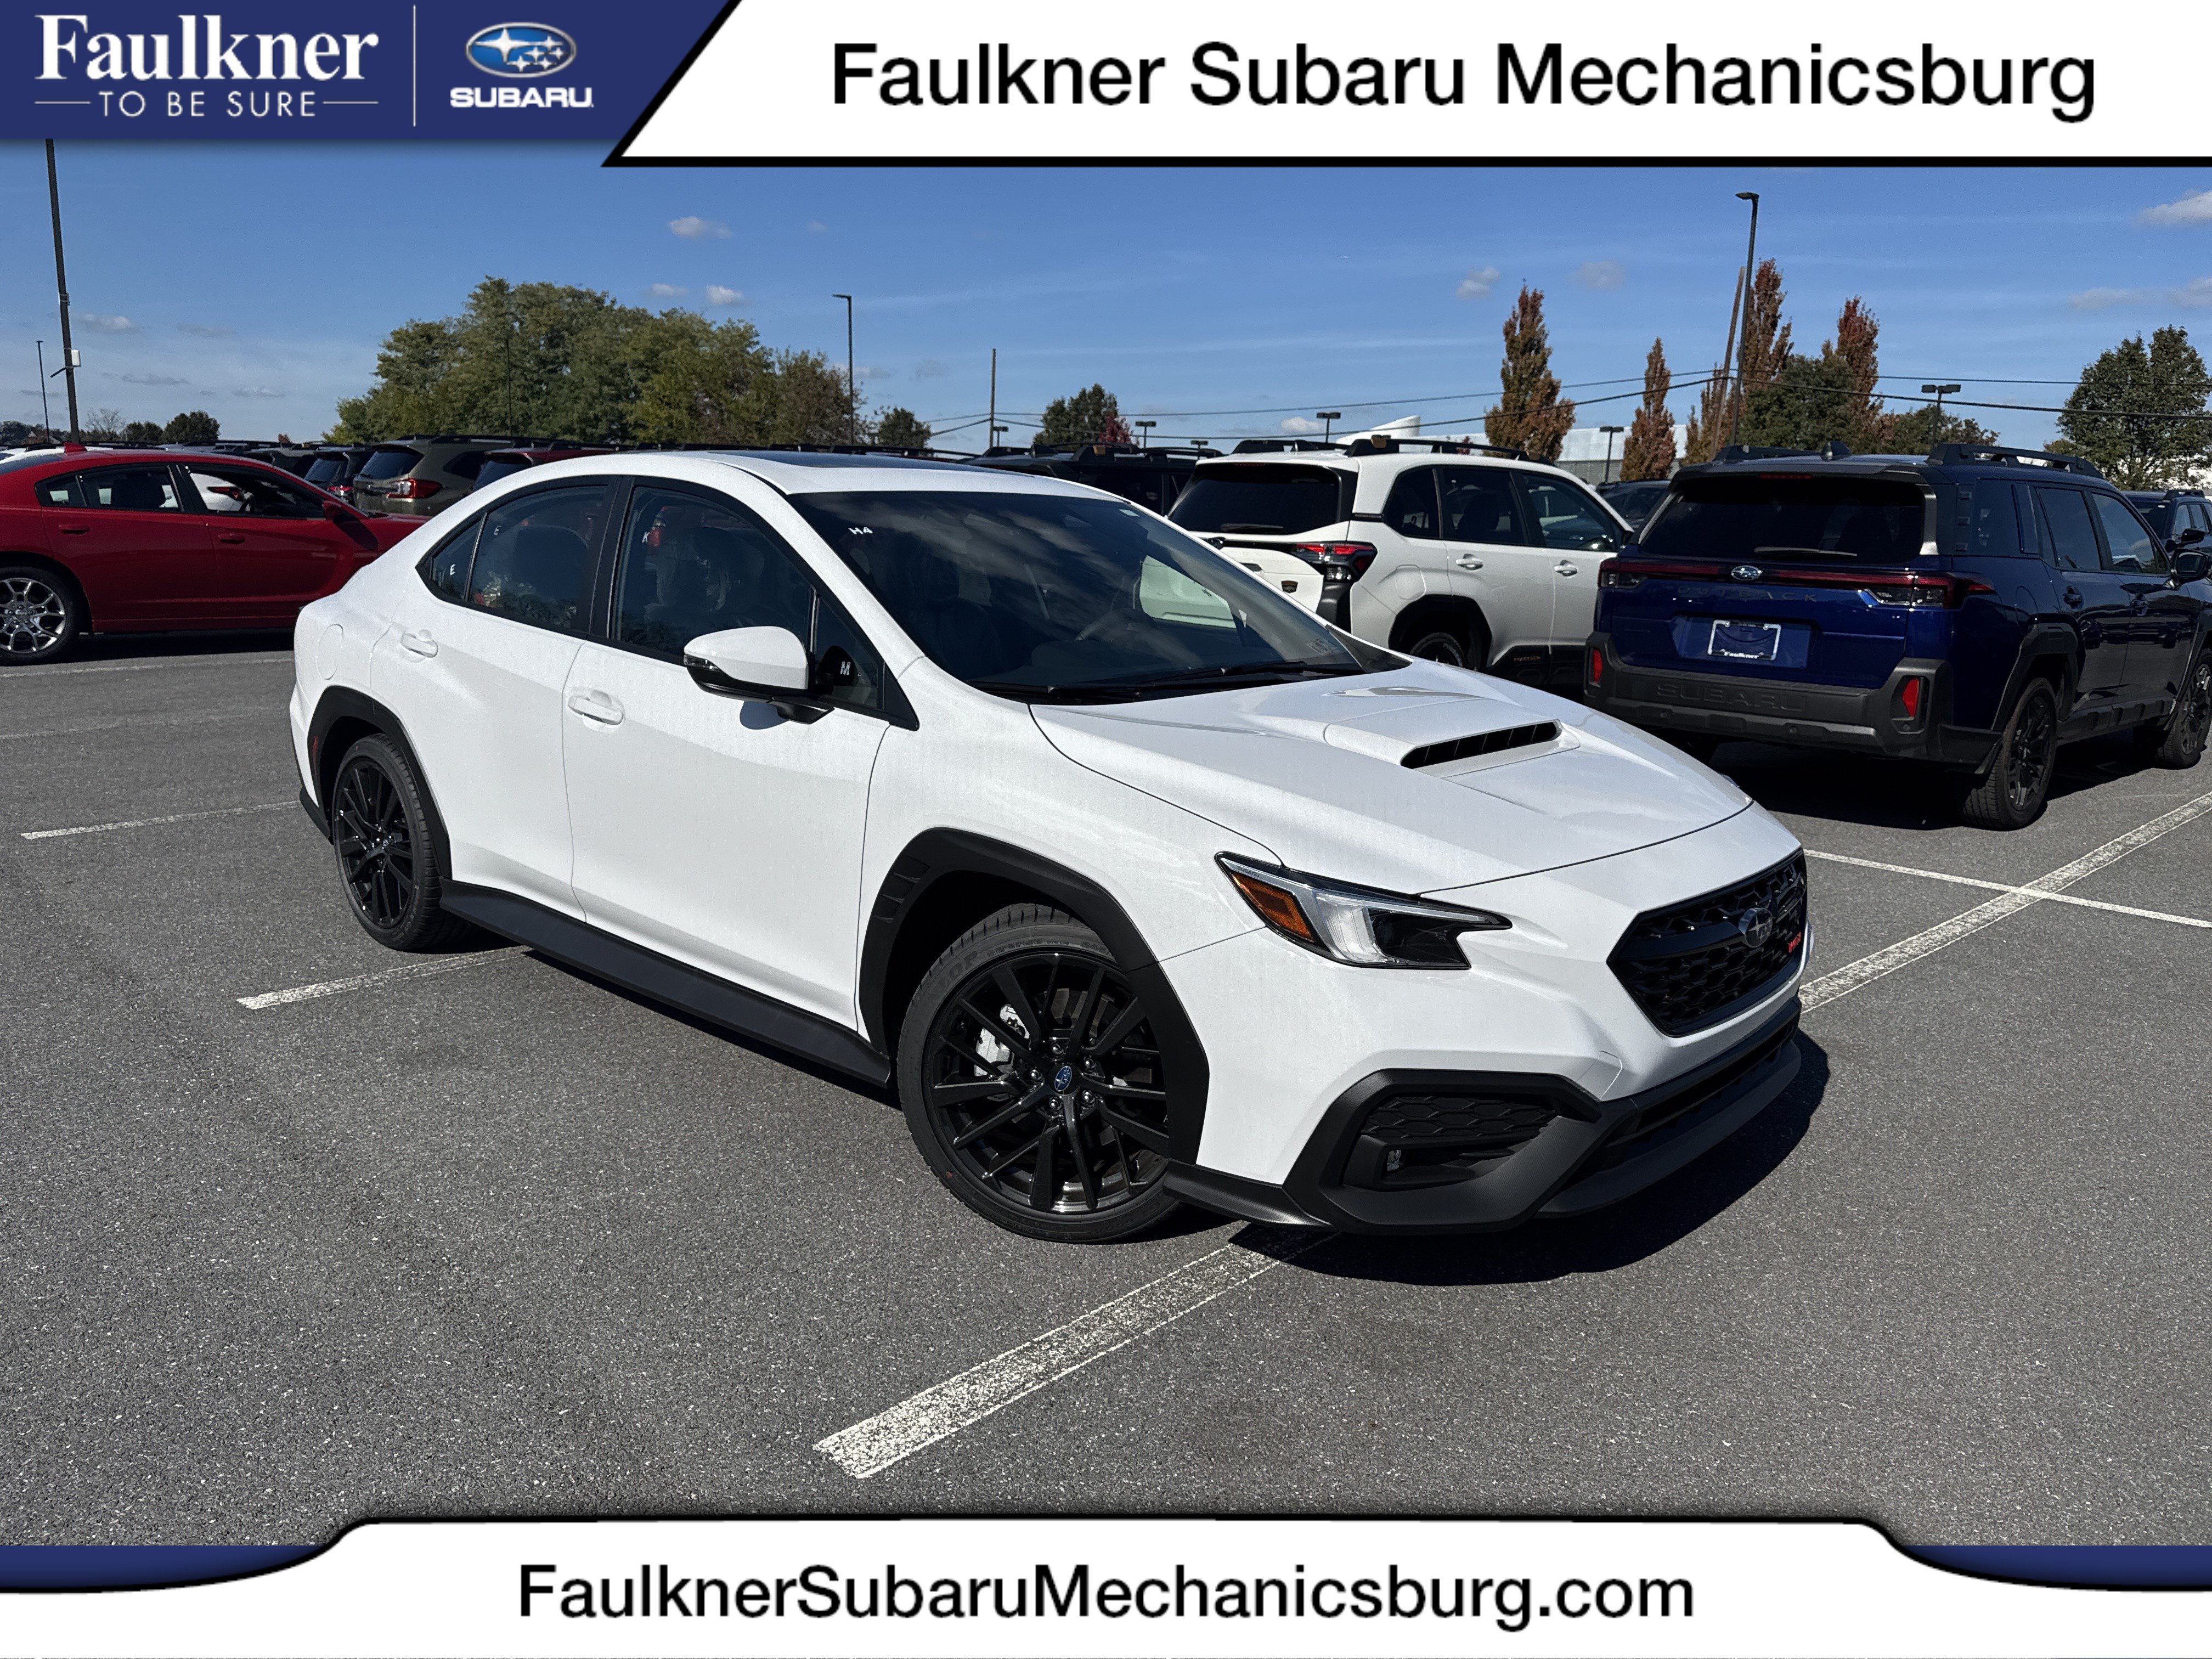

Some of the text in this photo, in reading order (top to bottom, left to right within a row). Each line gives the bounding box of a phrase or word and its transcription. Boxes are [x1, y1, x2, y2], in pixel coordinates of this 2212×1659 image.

[641, 531, 651, 543] K
[449, 563, 455, 576] E
[1677, 585, 1818, 603] OUTBACK
[840, 661, 851, 675] M
[1657, 682, 1808, 712] SUBARU
